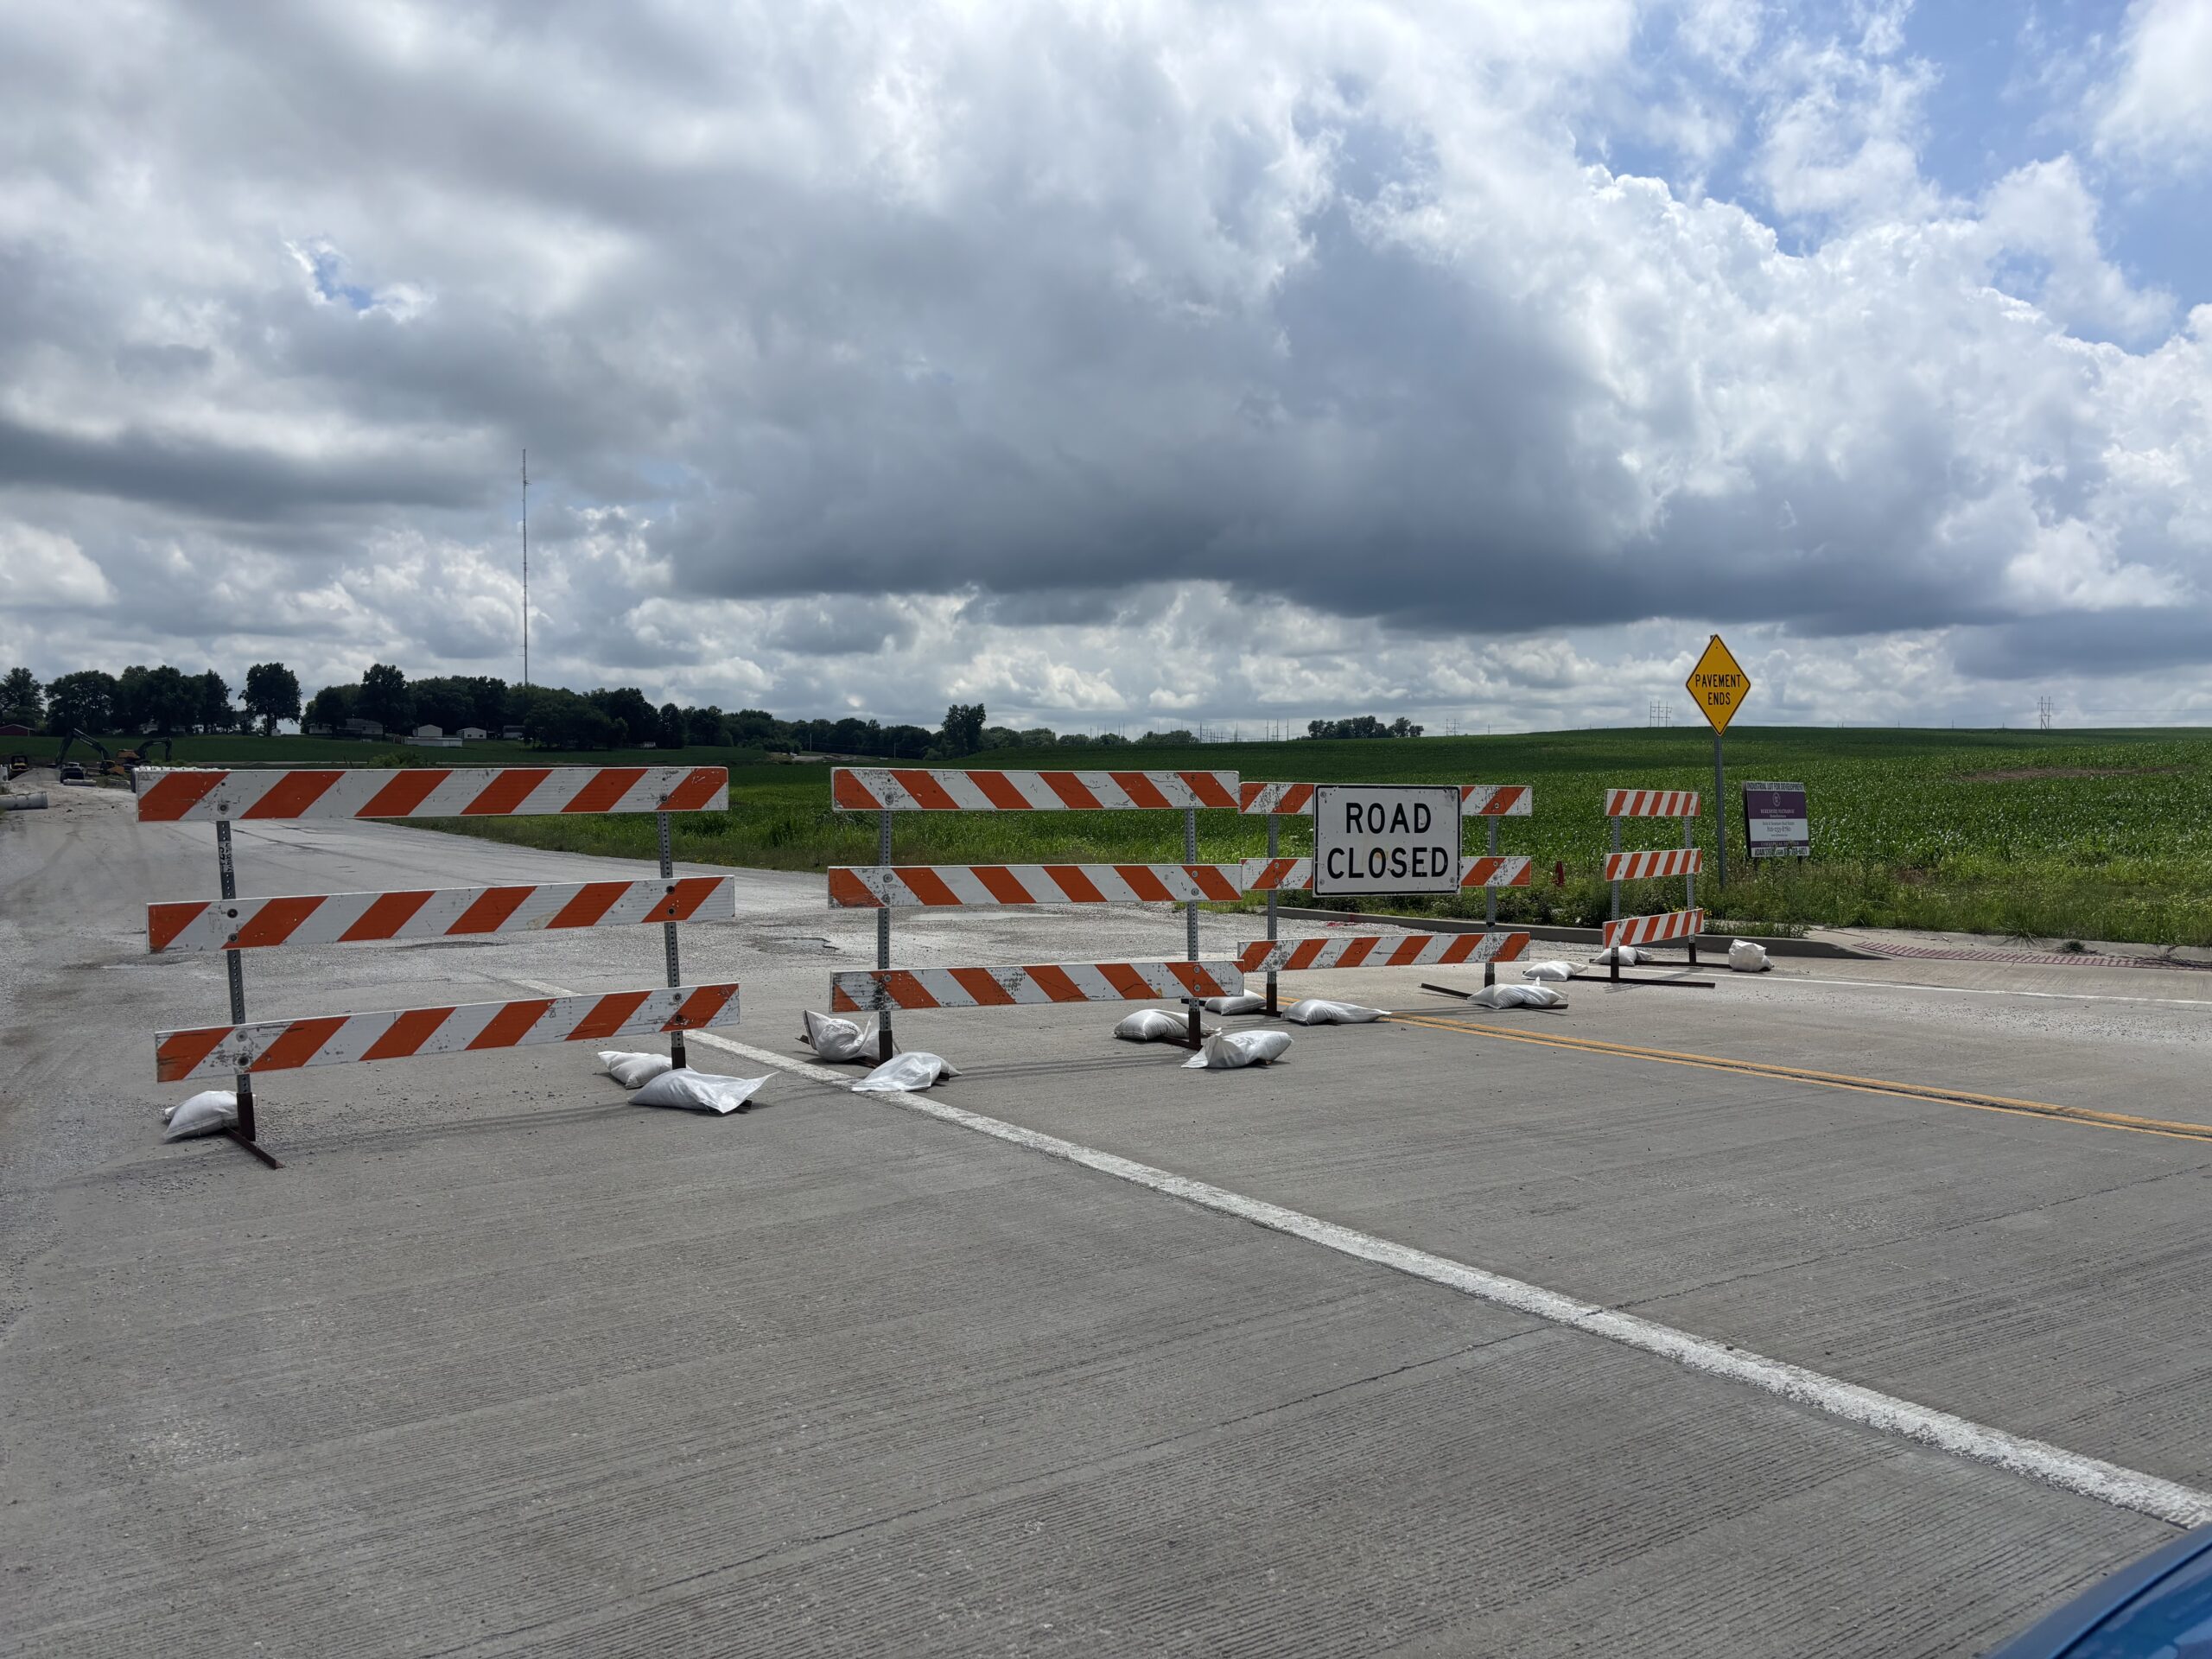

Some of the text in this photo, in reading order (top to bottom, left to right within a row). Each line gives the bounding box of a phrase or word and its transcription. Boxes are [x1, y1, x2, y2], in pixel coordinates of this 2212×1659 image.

[1695, 674, 1741, 688] PAVEMENT
[1707, 692, 1731, 706] ENDS
[1346, 803, 1431, 835] ROAD
[1327, 847, 1449, 880] CLOSED
